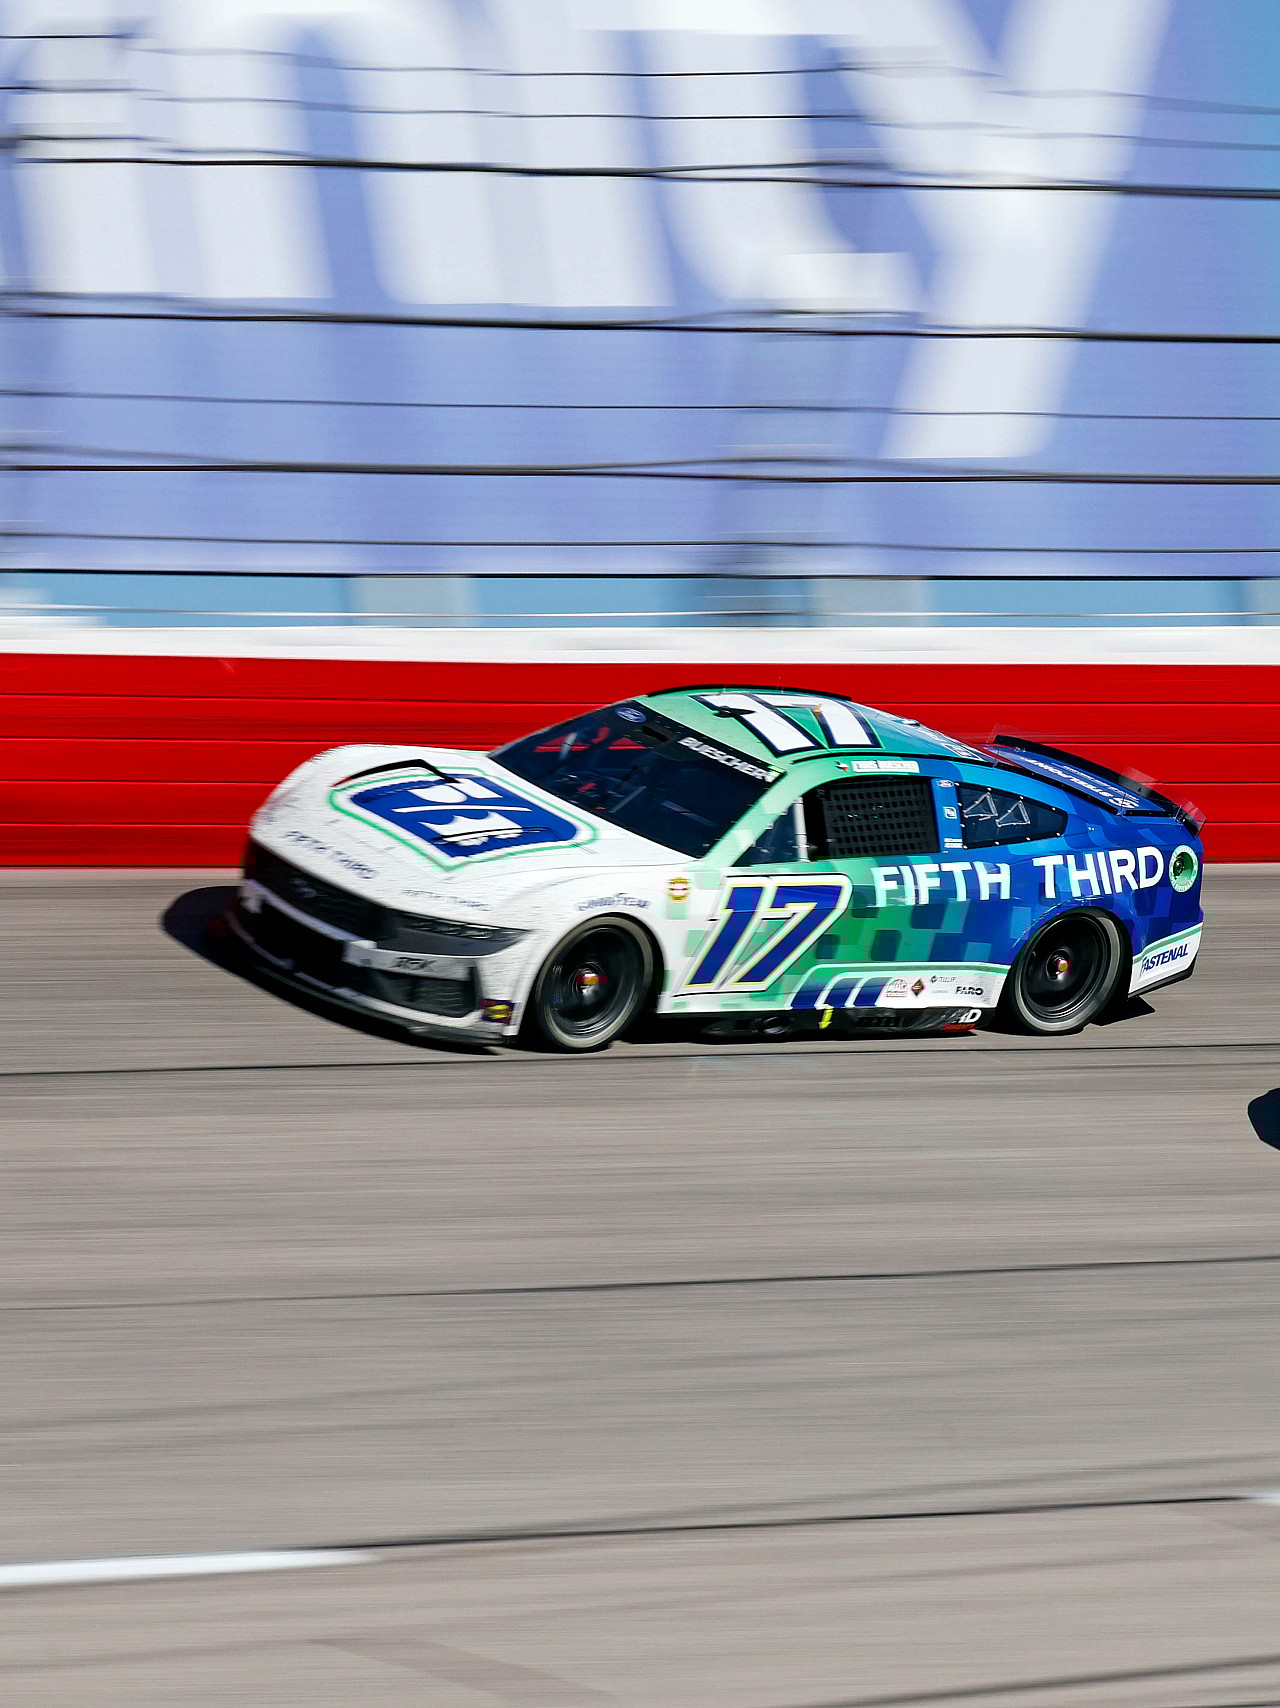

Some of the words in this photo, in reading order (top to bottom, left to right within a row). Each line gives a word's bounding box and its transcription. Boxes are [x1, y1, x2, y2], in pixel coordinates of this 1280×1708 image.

[690, 692, 882, 756] 17
[677, 737, 772, 780] BUESCHER
[873, 861, 1011, 907] FIFTH
[1032, 846, 1164, 899] THIRD
[681, 876, 850, 991] 17
[1141, 943, 1189, 975] FASTENAL
[955, 986, 984, 996] FARO
